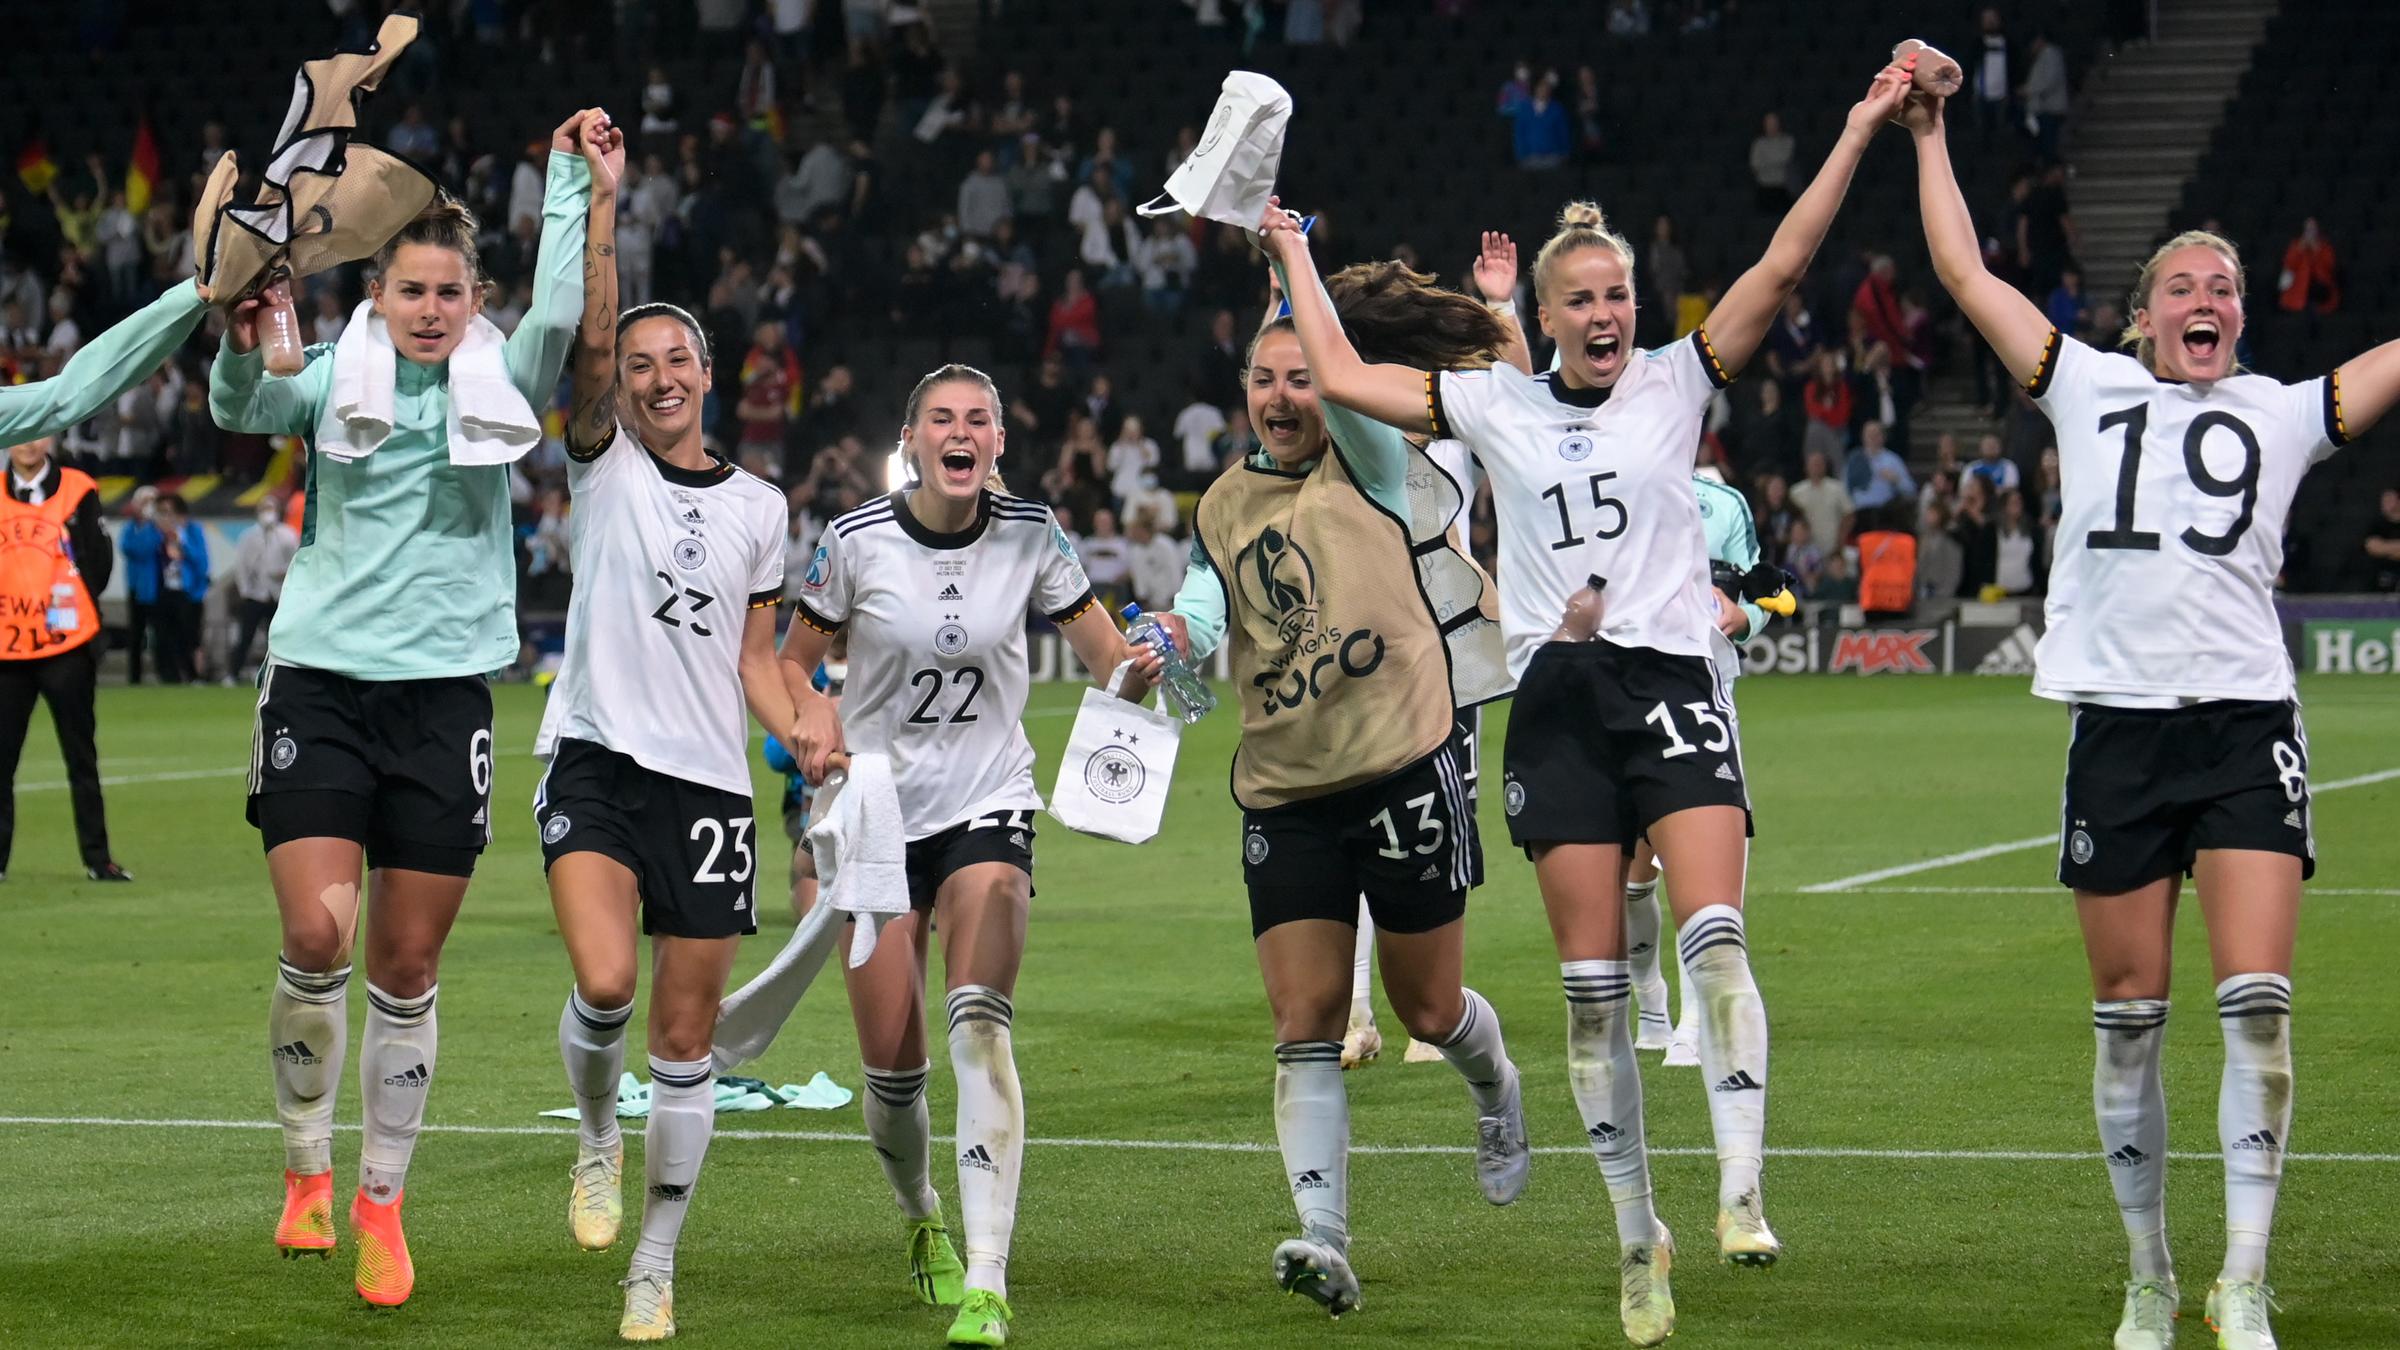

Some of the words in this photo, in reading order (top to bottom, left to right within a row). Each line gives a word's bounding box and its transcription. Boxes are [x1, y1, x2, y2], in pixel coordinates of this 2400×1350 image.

[1541, 470, 1629, 551] 15
[2086, 400, 2261, 556] 19
[651, 570, 715, 636] 23
[1827, 629, 1938, 676] MAX
[907, 666, 985, 725] 22
[469, 728, 490, 796] 6
[1644, 700, 1730, 759] 15
[689, 816, 753, 883] 23
[1369, 791, 1444, 860] 13
[272, 1049, 323, 1066] adidas
[958, 1157, 1000, 1174] adidas
